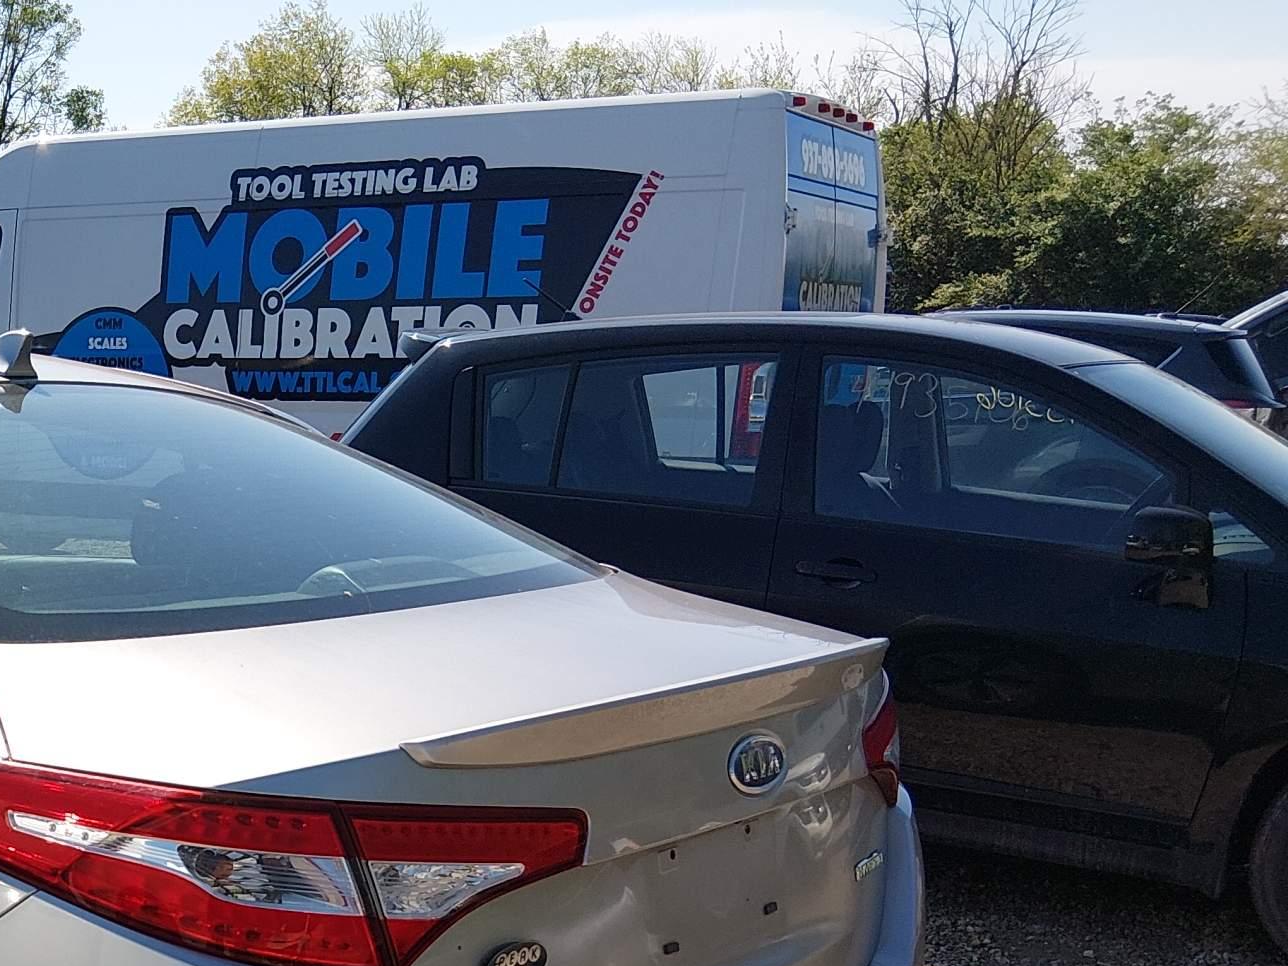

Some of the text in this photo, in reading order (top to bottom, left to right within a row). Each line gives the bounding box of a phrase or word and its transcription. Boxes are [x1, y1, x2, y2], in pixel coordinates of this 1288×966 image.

[237, 165, 479, 201] TOOL TESTING LAB
[165, 199, 550, 305] MOBILE
[579, 170, 665, 314] ONSITE TODAY!
[95, 318, 122, 330] CMM
[88, 337, 128, 350] SCALES
[741, 746, 781, 783] KIA
